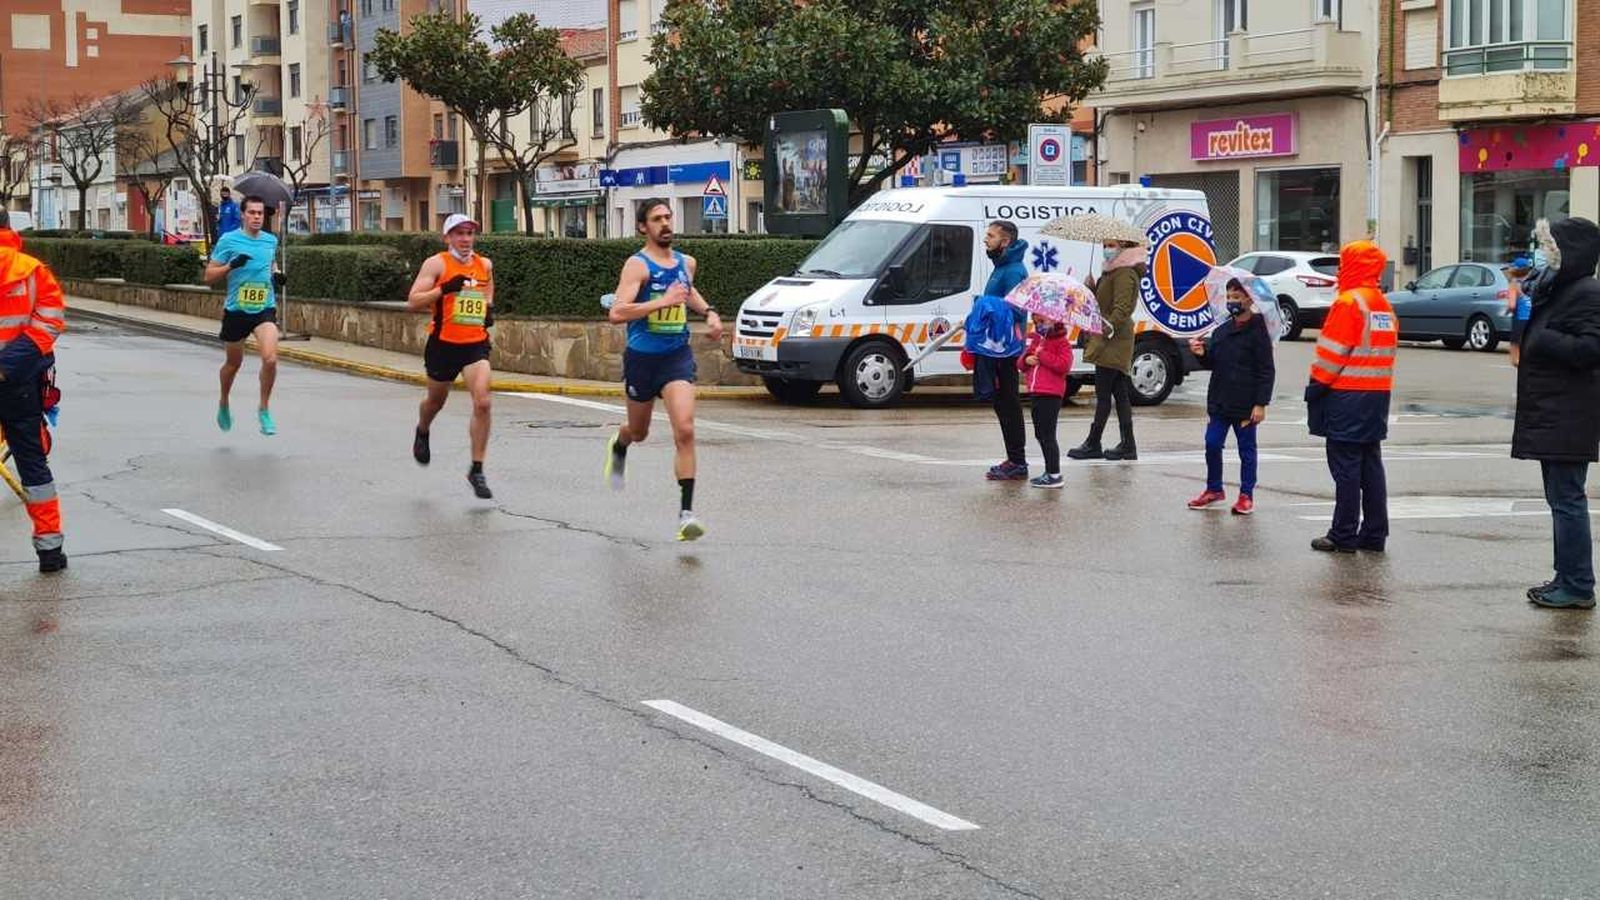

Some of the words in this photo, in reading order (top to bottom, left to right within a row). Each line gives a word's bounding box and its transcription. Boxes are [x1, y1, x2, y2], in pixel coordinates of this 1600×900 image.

[1208, 121, 1273, 155] revitex
[1140, 216, 1182, 313] PROCCION
[1187, 217, 1216, 247] CIV
[243, 289, 265, 301] 186
[458, 299, 483, 314] 189
[829, 307, 846, 318] L-1
[1168, 306, 1214, 328] BENAV
